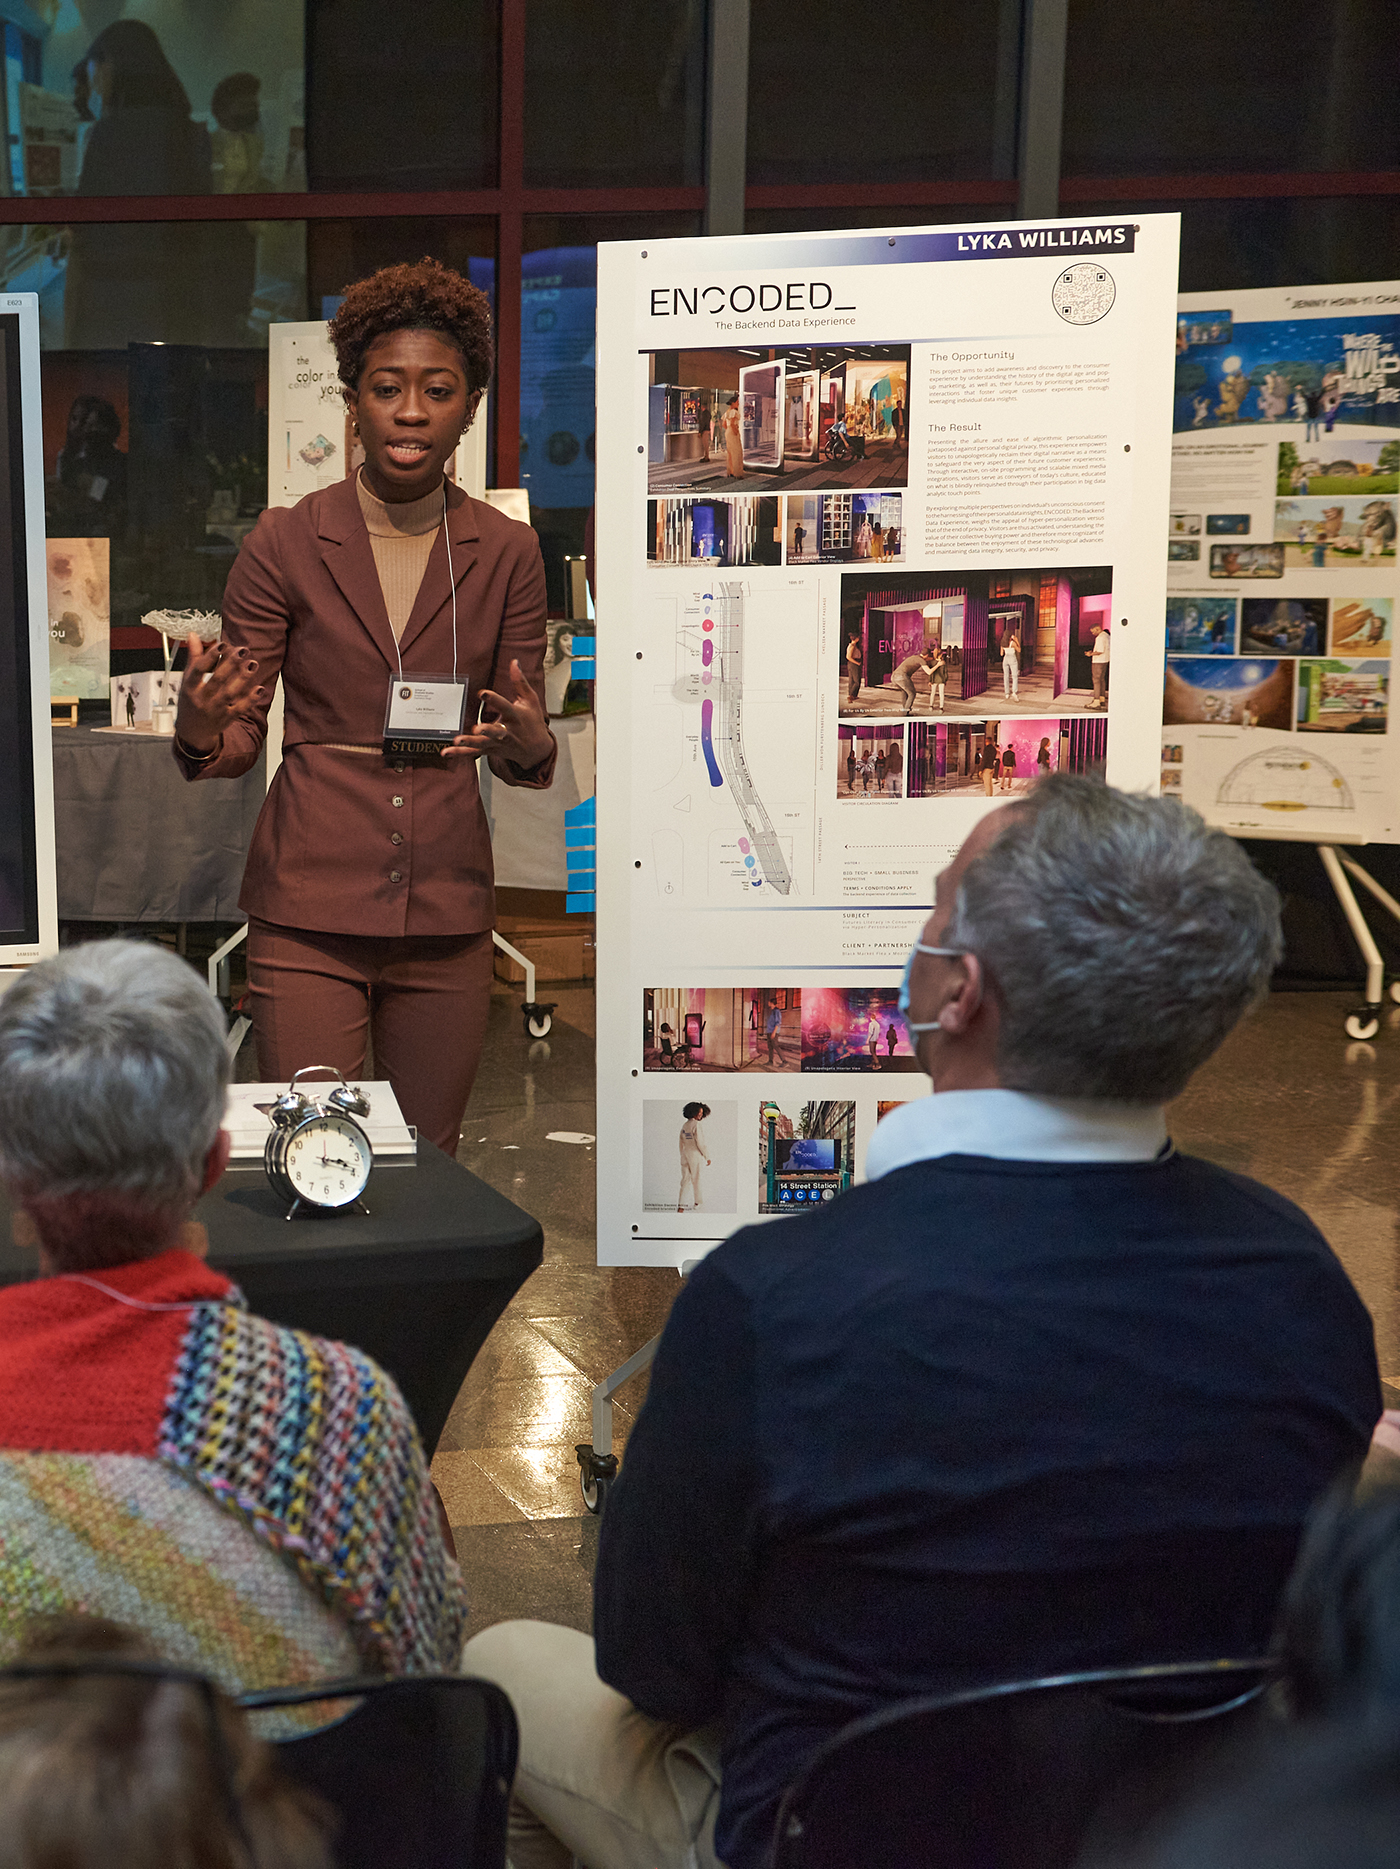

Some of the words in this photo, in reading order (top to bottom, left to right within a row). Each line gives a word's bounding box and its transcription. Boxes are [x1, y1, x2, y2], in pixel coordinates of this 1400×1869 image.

[958, 234, 1012, 251] LYKA
[1019, 228, 1126, 248] WILLIAMS
[651, 282, 856, 316] ENCODED_
[1292, 299, 1328, 309] JENNY
[715, 320, 732, 330] The
[735, 319, 775, 329] Backend
[779, 318, 800, 328] Data
[804, 317, 856, 328] Experience
[297, 356, 309, 365] the
[930, 353, 948, 362] The
[951, 350, 1015, 362] Opportunity
[296, 369, 323, 382] color
[327, 370, 335, 379] in
[321, 386, 341, 398] you
[949, 423, 981, 432] Result
[391, 741, 450, 754] STUDENT
[319, 1123, 328, 1132] 12
[338, 1127, 342, 1135] 1
[305, 1128, 312, 1137] 11
[295, 1141, 302, 1150] 10
[349, 1138, 354, 1147] 2
[290, 1156, 296, 1165] 9
[354, 1152, 360, 1162] 3
[296, 1171, 301, 1180] 8
[309, 1182, 314, 1191] 7
[339, 1180, 345, 1189] 5
[324, 1185, 329, 1194] 6
